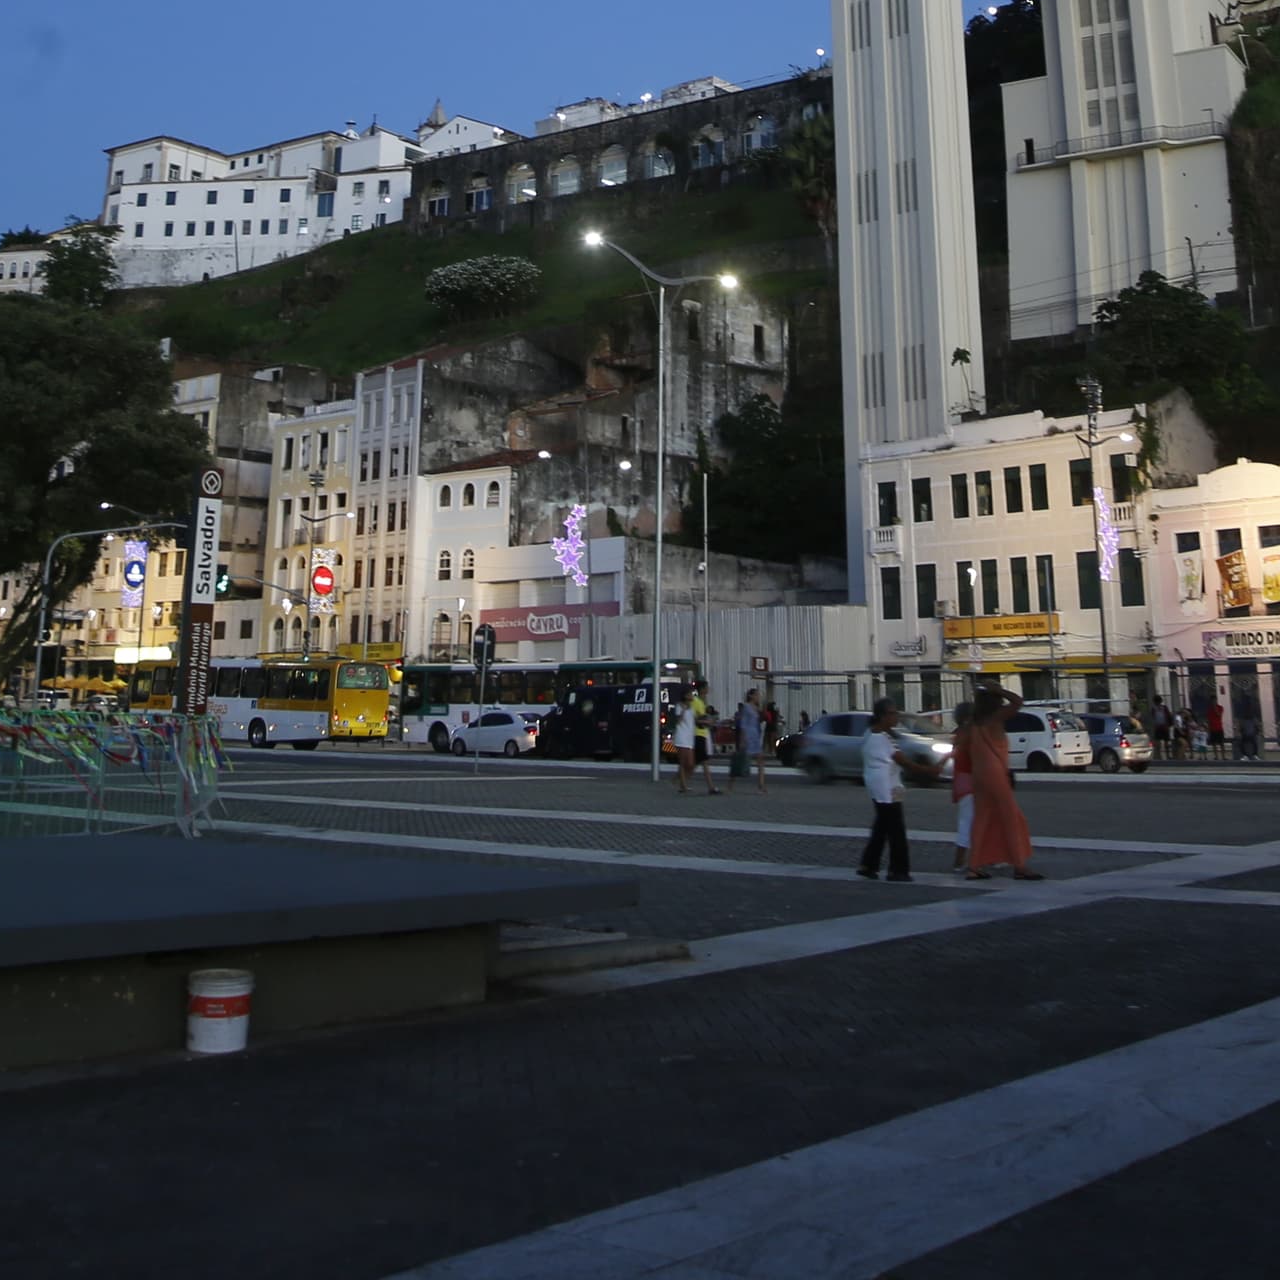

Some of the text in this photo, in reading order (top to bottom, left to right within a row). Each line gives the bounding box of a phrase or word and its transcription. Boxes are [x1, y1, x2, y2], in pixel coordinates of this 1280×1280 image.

[196, 505, 216, 595] Salvador
[189, 622, 201, 667] Mundial
[529, 615, 564, 633] CAYRU
[1225, 631, 1264, 647] MUNDO
[196, 622, 212, 705] World Heritage
